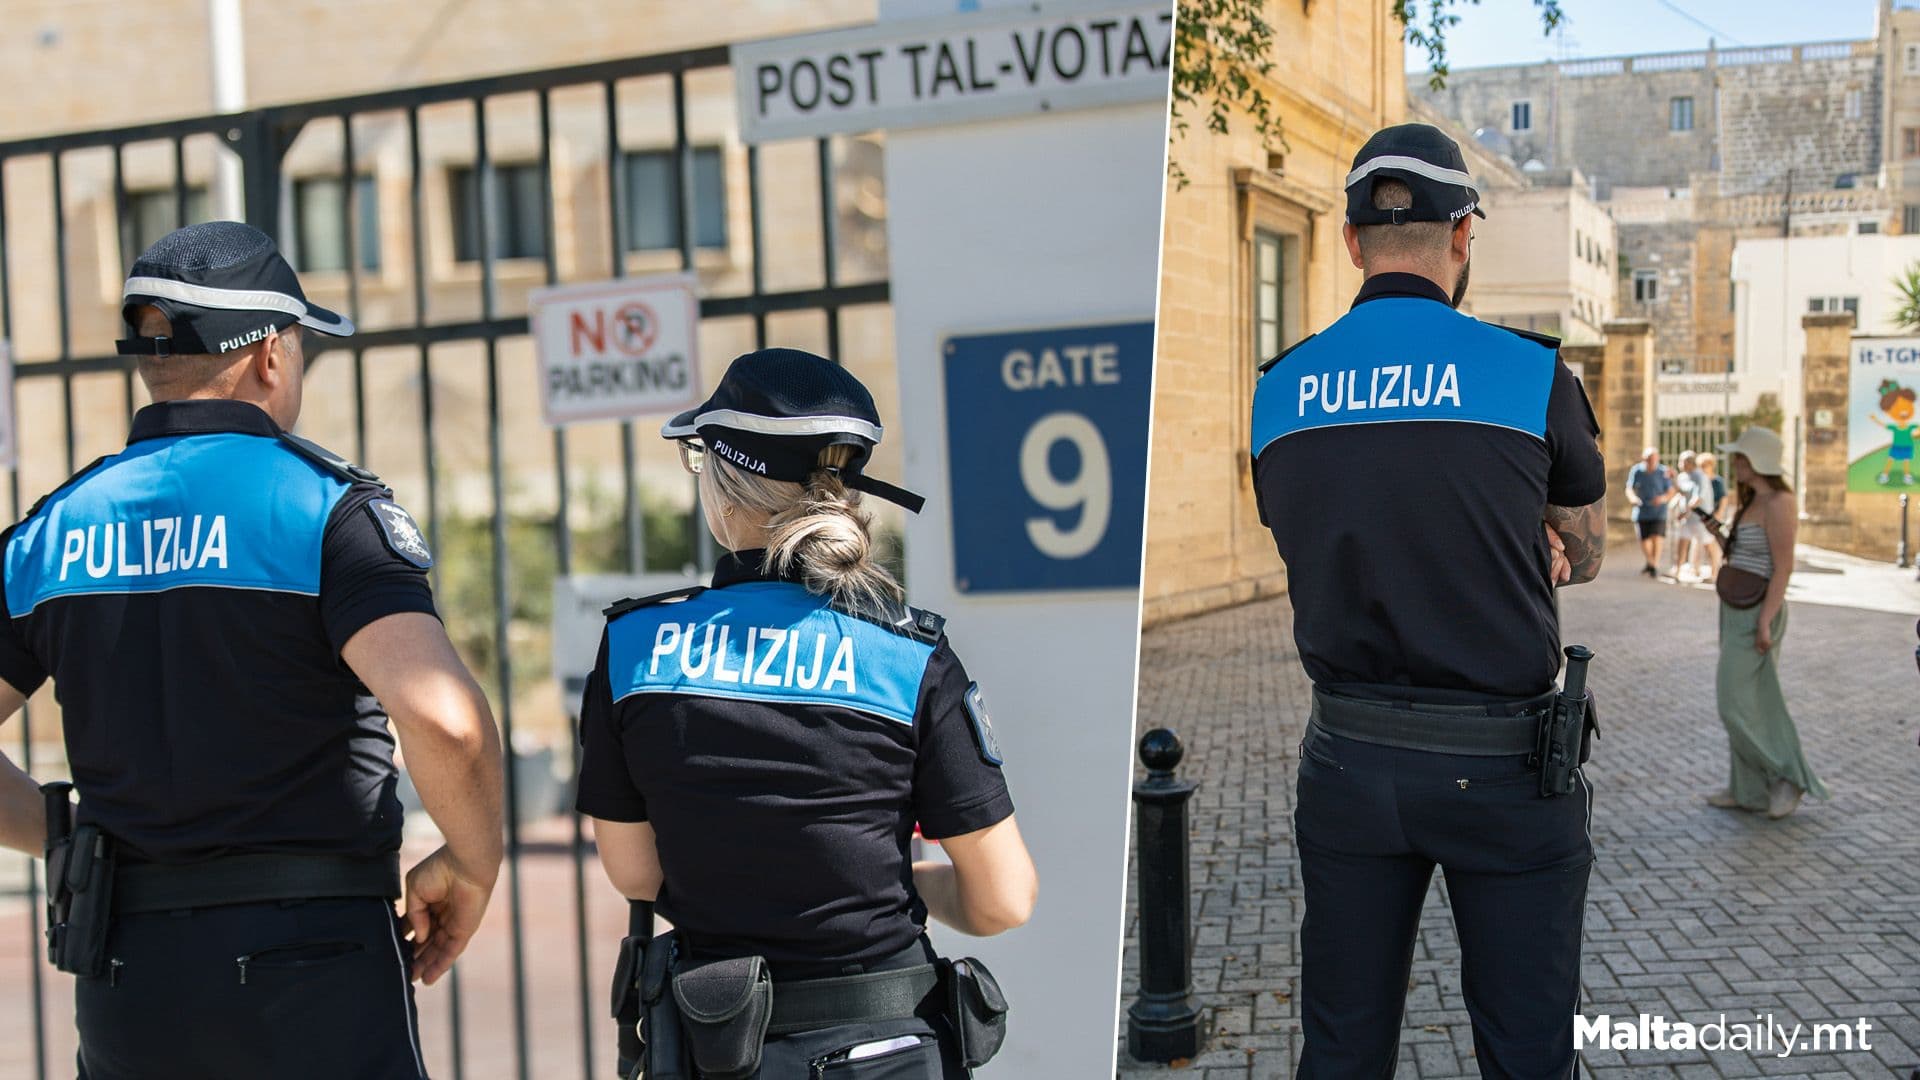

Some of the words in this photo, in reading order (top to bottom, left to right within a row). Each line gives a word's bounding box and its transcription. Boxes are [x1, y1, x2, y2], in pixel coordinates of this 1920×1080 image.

[758, 51, 884, 116] POST
[220, 323, 277, 353] PULIZIJA
[549, 355, 687, 399] PARKING
[1002, 345, 1120, 391] GATE
[1298, 363, 1462, 417] PULIZIJA
[714, 440, 767, 475] PULIZIJA
[1019, 411, 1113, 560] 9
[58, 515, 228, 582] PULIZIJA
[649, 622, 857, 693] PULIZIJA
